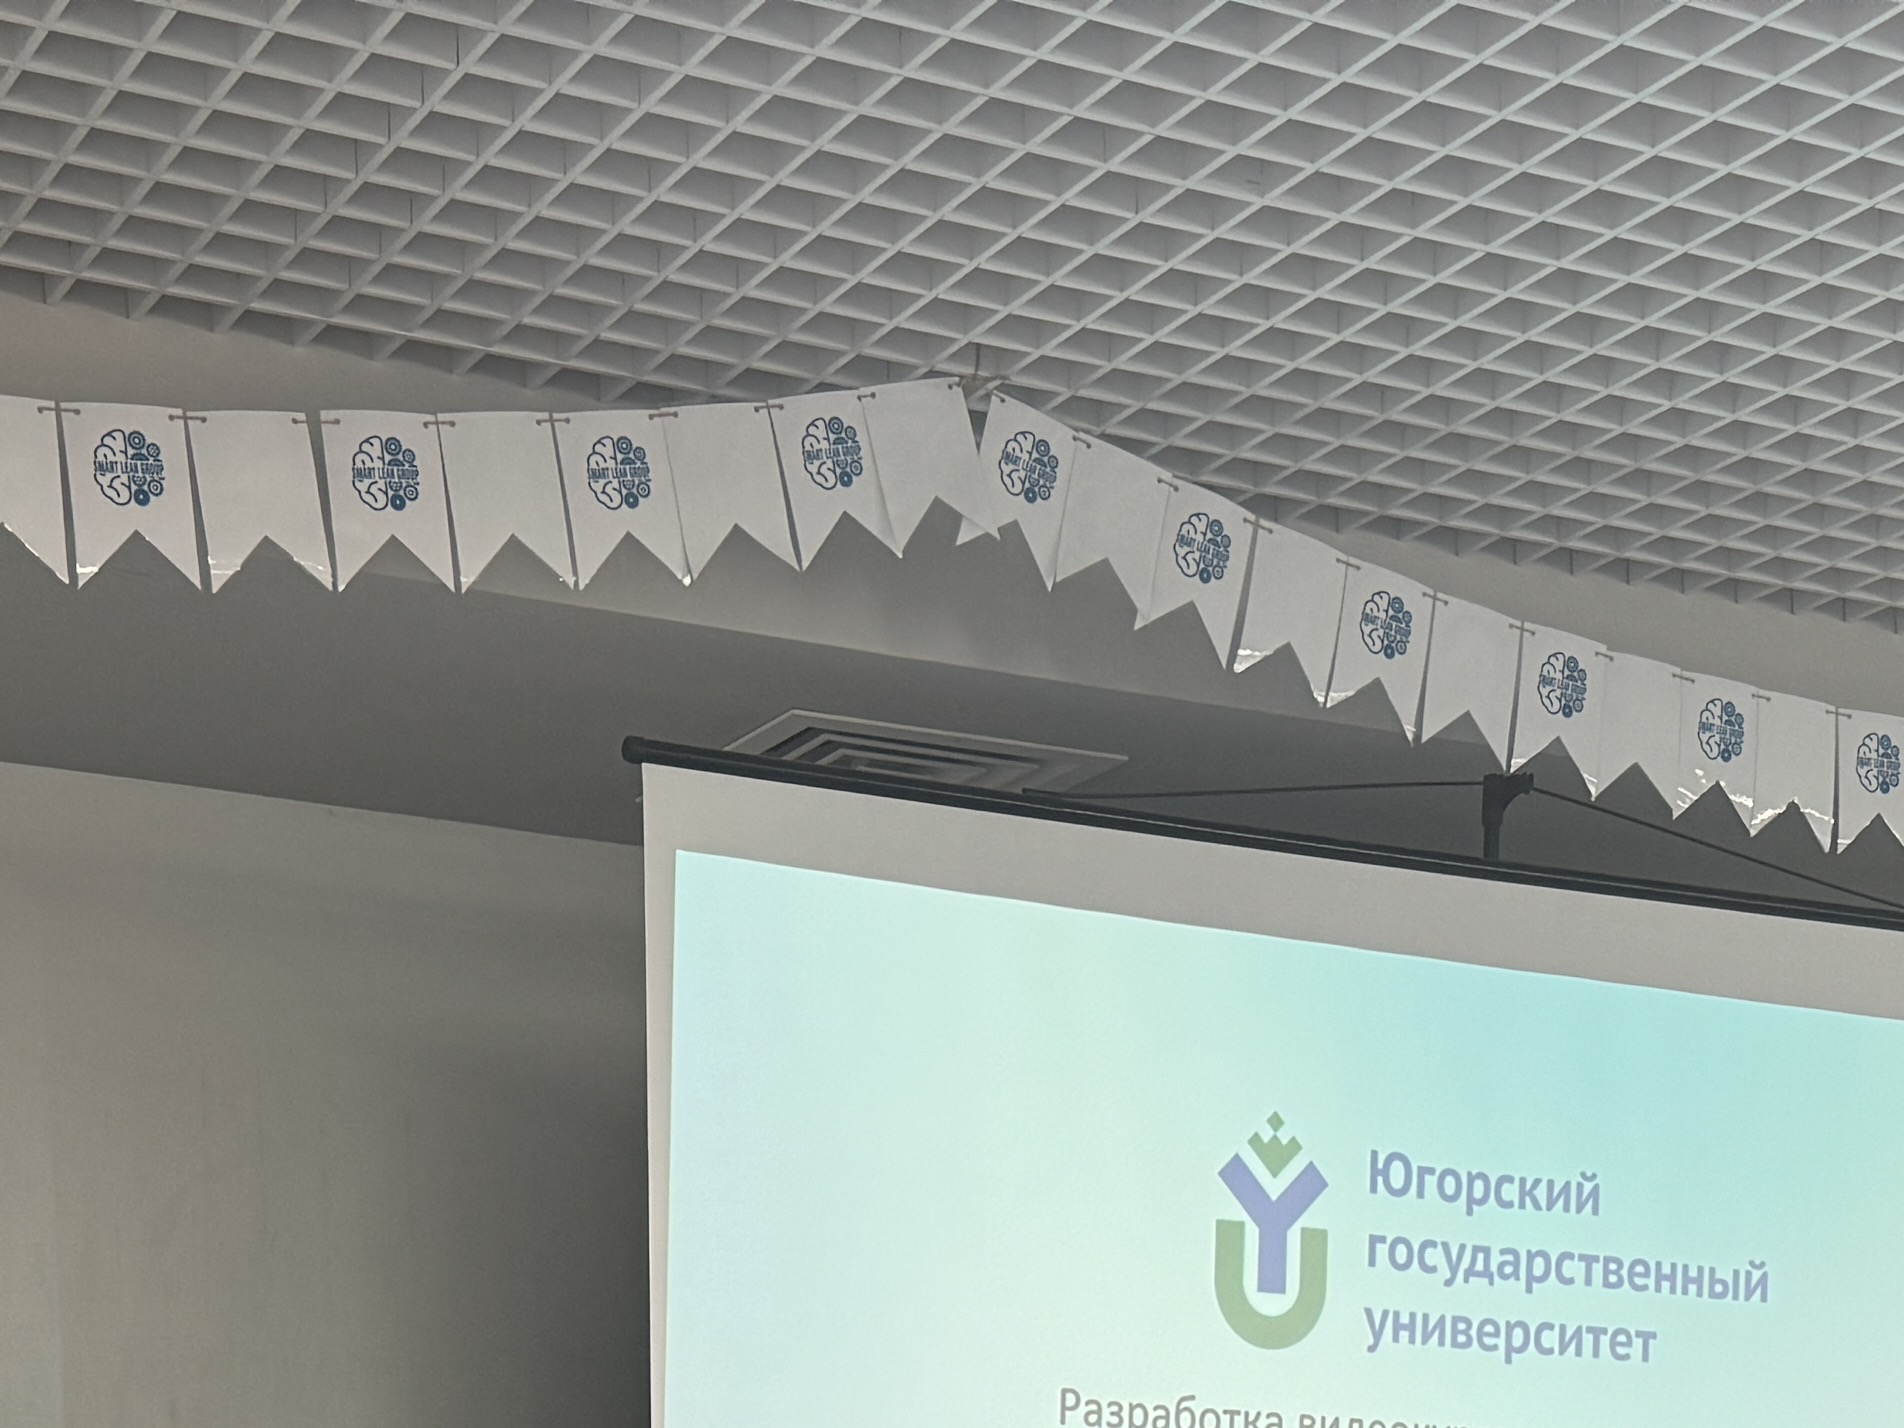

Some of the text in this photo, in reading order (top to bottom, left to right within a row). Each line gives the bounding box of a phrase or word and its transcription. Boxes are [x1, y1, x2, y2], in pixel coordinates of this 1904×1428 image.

[1369, 1149, 1600, 1218] Югорский
[1367, 1233, 1769, 1304] государственный
[1363, 1306, 1658, 1366] университет
